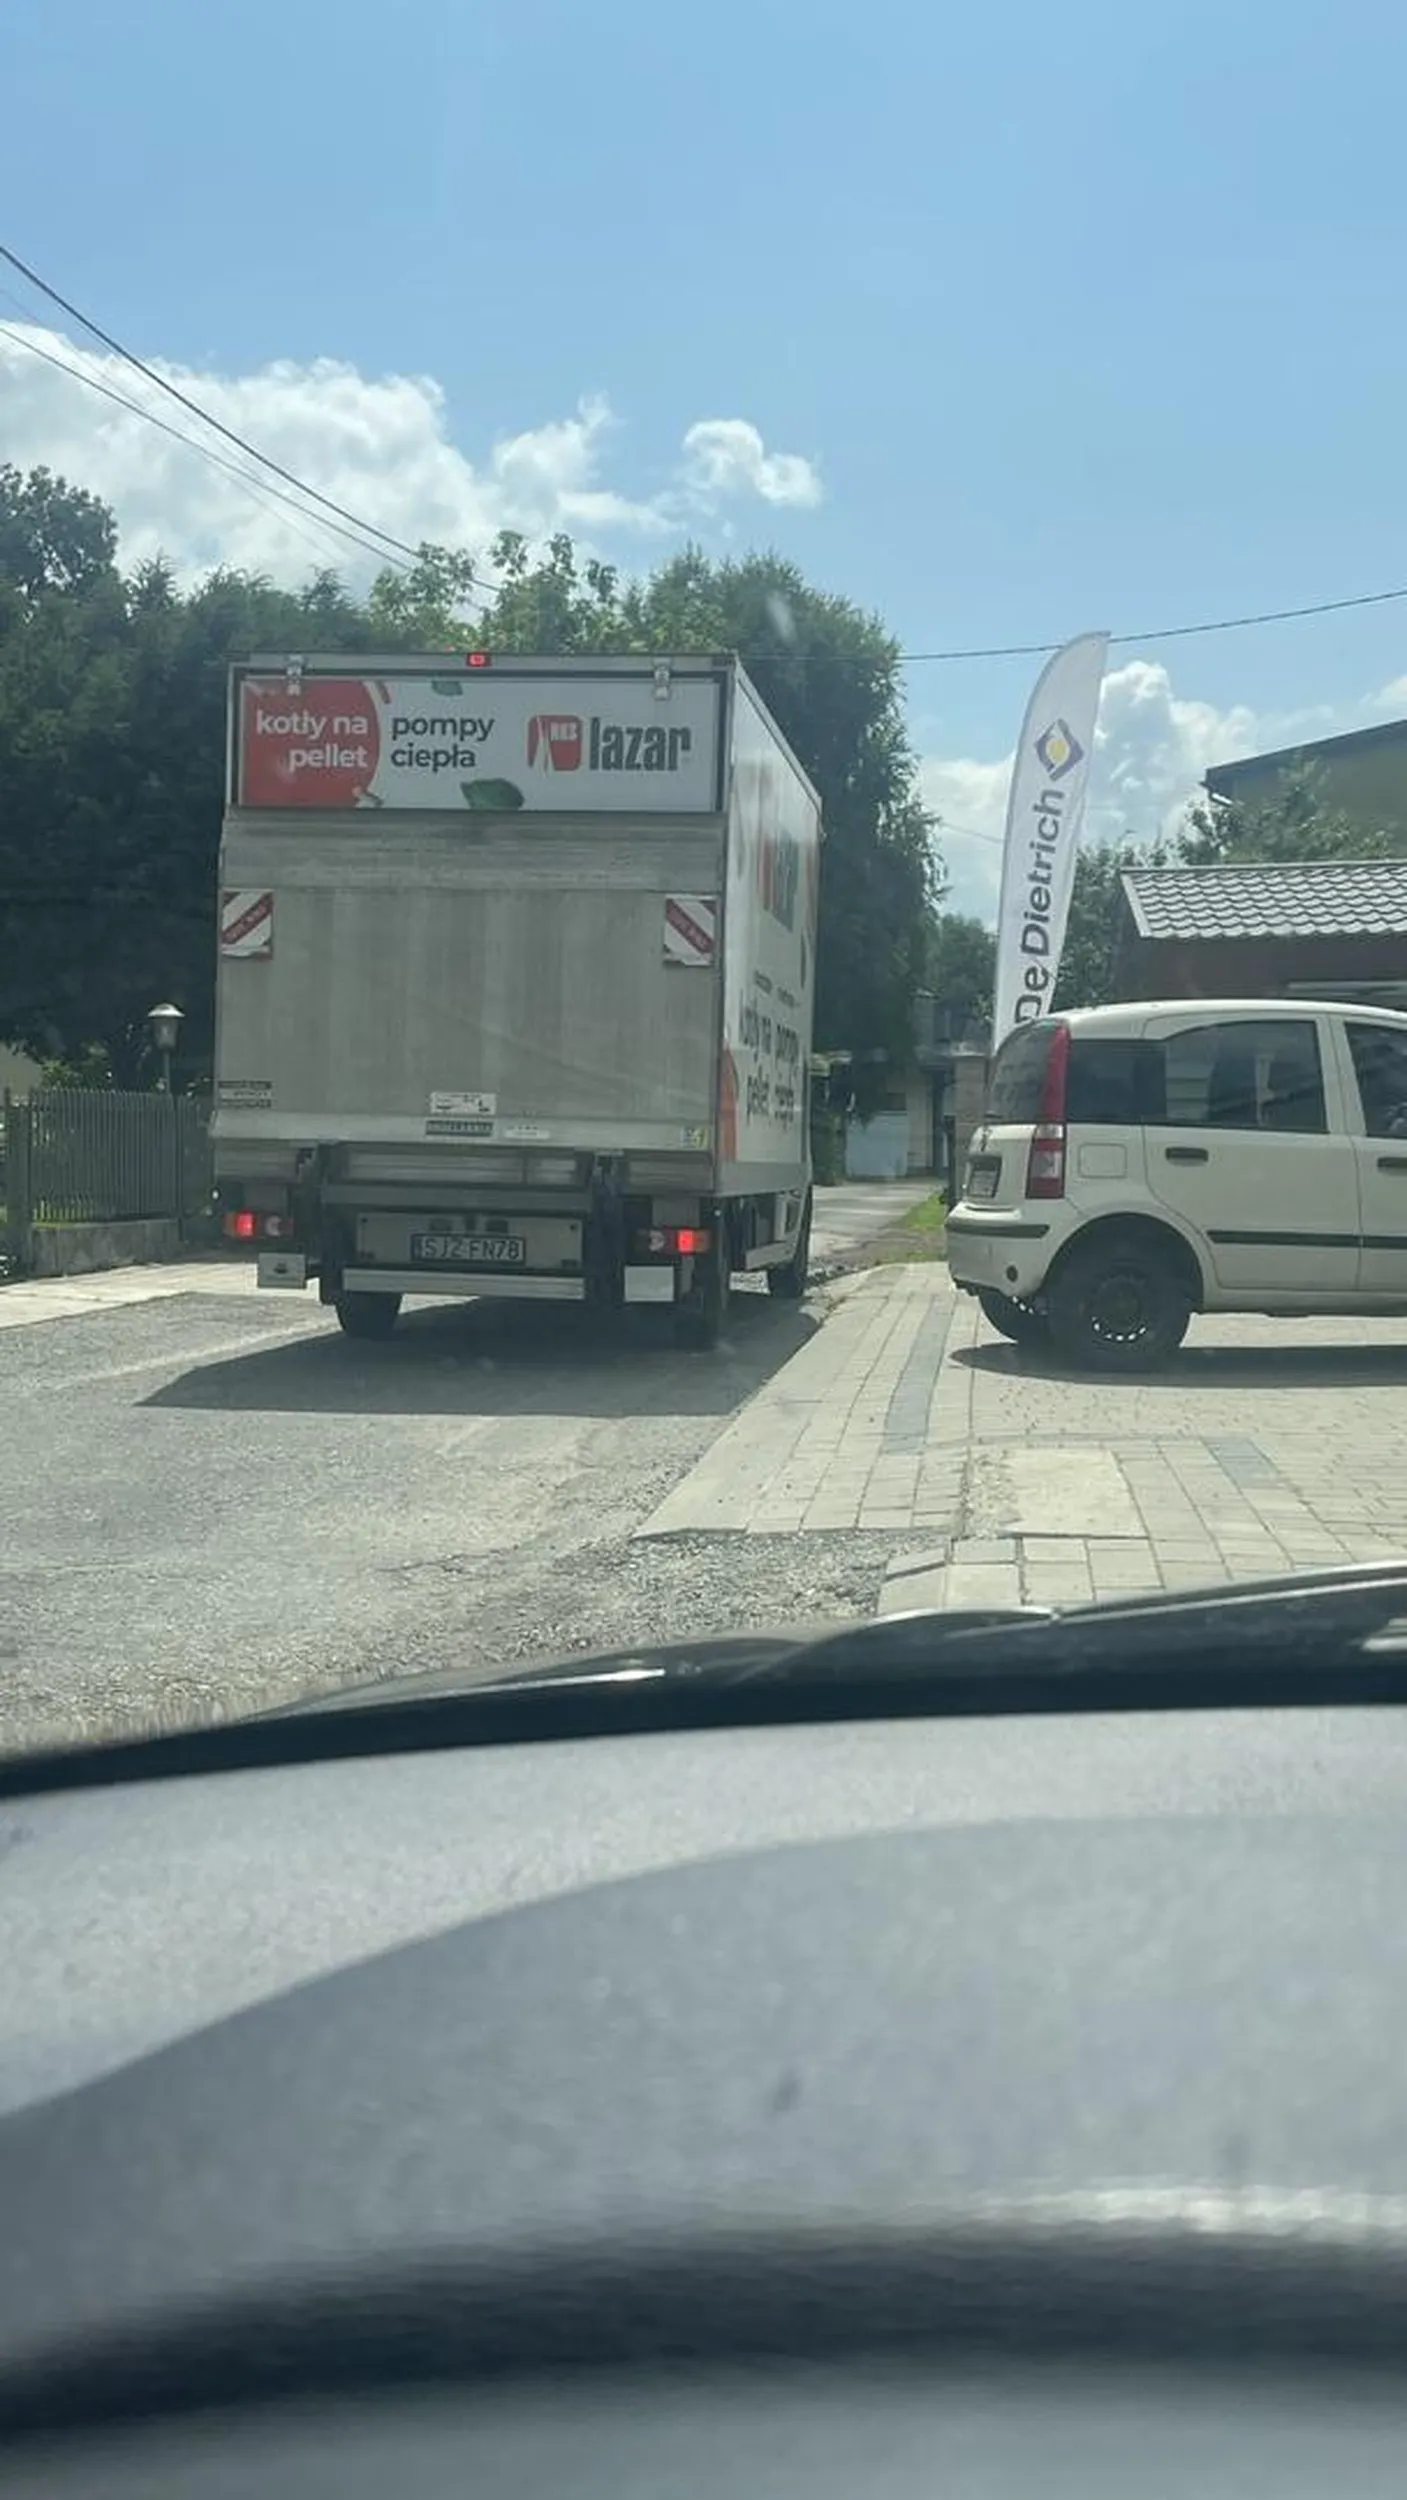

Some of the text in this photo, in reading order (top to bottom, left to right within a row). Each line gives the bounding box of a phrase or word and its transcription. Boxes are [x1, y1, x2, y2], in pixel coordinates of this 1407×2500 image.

[333, 715, 368, 735] na
[391, 717, 496, 742] pompy
[288, 742, 368, 772] pellet
[391, 742, 477, 773] ciepła
[589, 716, 691, 772] lazar
[1014, 788, 1065, 1025] De Dietrich
